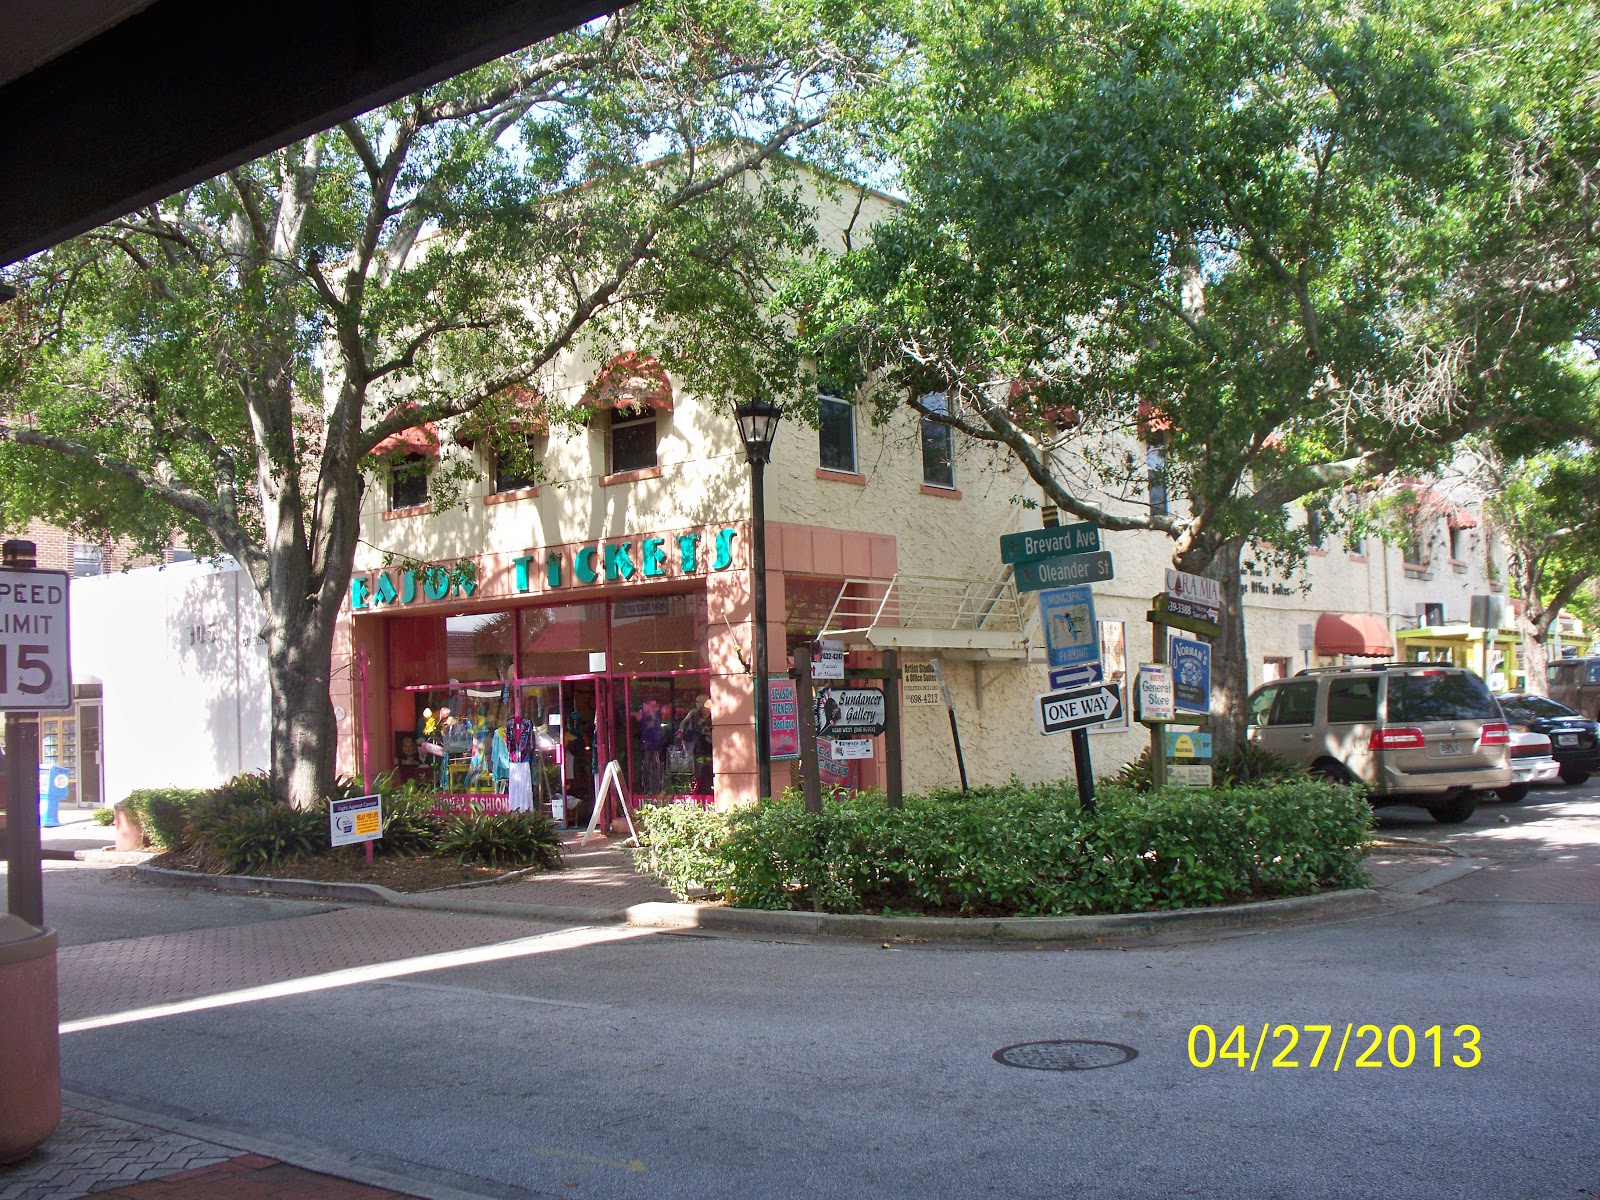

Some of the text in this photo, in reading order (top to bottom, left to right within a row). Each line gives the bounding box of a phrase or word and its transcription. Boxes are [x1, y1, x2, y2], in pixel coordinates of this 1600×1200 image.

[1024, 529, 1096, 555] Brevard Ave
[352, 527, 738, 609] EASON TICKETS
[1038, 560, 1109, 583] Oleander St
[0, 584, 62, 605] PEED
[1200, 576, 1217, 601] MIA
[1251, 581, 1269, 594] Office
[1047, 591, 1085, 606] MUNICIPAL
[0, 613, 52, 634] IMIT
[1058, 647, 1089, 662] PARKING
[0, 644, 53, 695] 15
[772, 687, 793, 701] SEASON
[1142, 680, 1171, 693] General
[838, 691, 883, 706] Sundancer
[1148, 693, 1169, 705] Store
[772, 703, 794, 717] TICKETS
[845, 706, 877, 724] Gallery
[1049, 695, 1109, 721] ONE WAY
[773, 717, 795, 733] Boutique
[819, 758, 849, 778] CKETS
